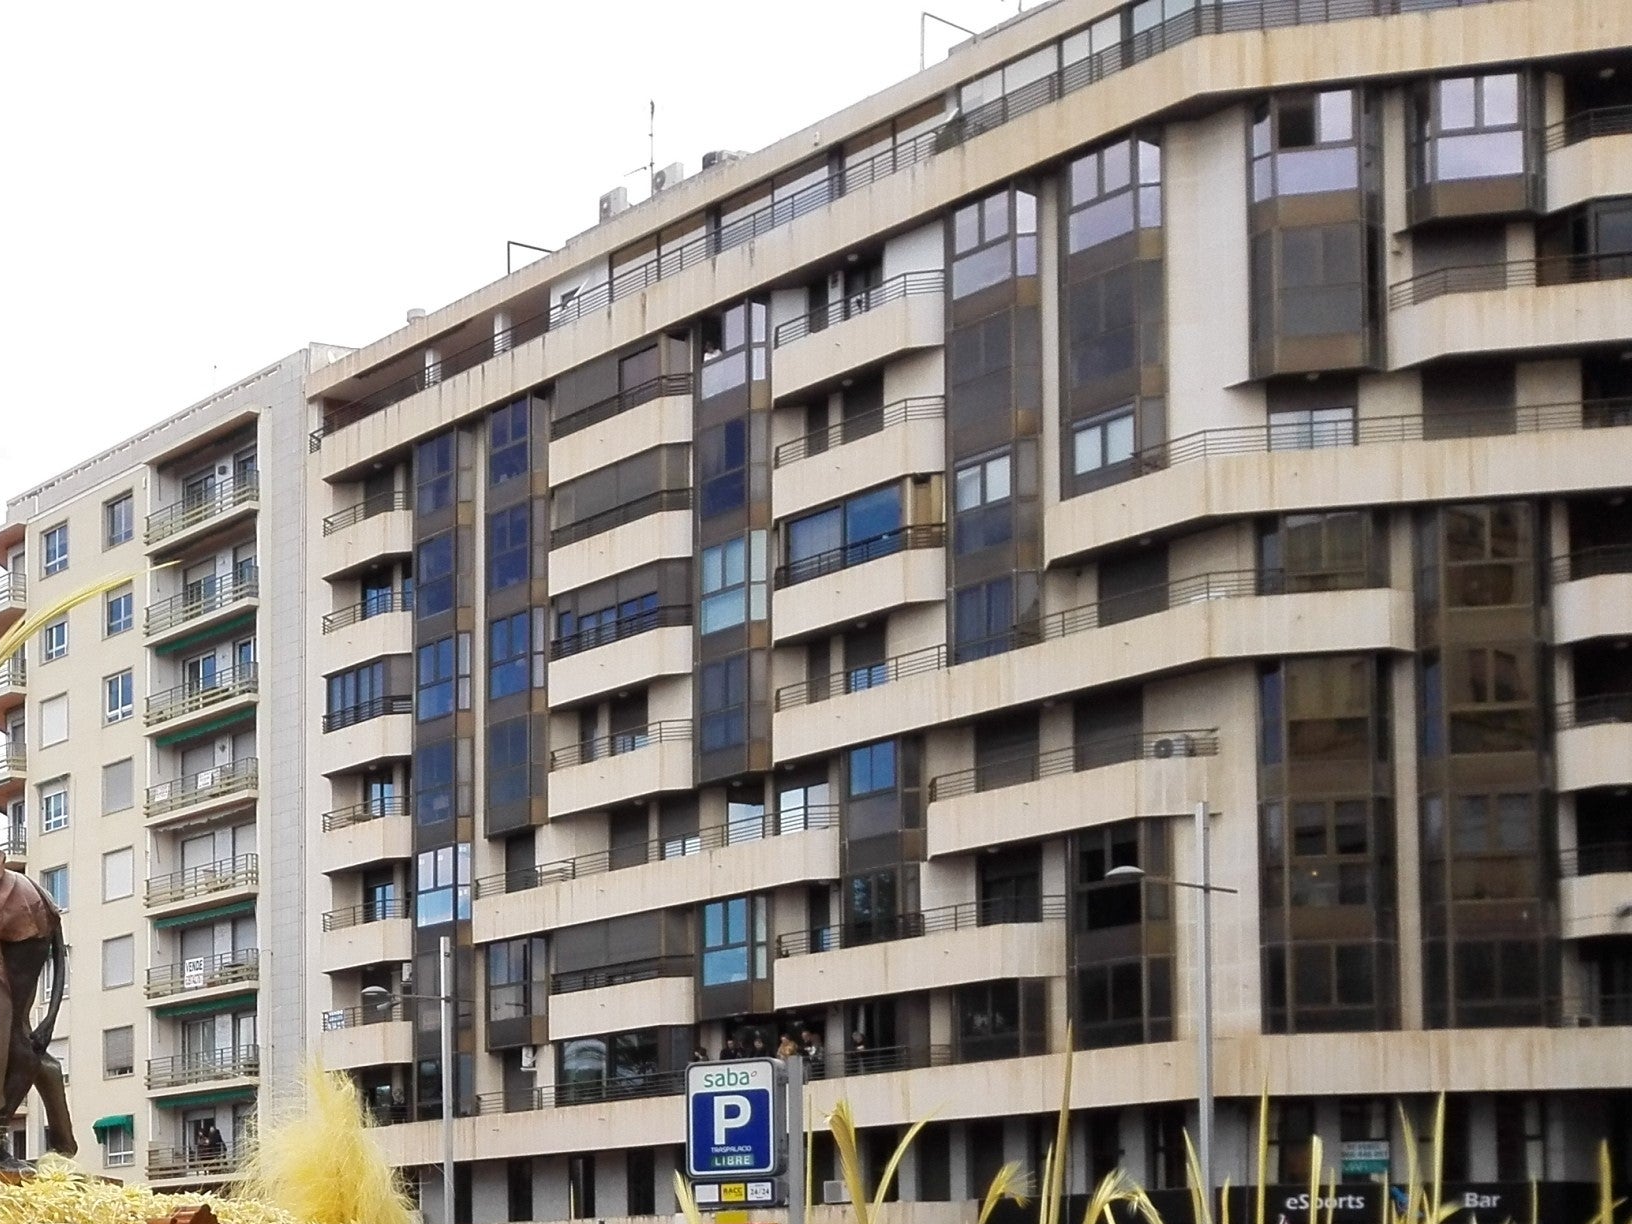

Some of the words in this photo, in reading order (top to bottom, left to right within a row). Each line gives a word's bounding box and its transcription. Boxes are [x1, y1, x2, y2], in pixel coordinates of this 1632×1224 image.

[704, 1067, 750, 1088] saba
[713, 1095, 752, 1145] P
[714, 1155, 751, 1166] LIBRE
[1464, 1192, 1501, 1208] Bar
